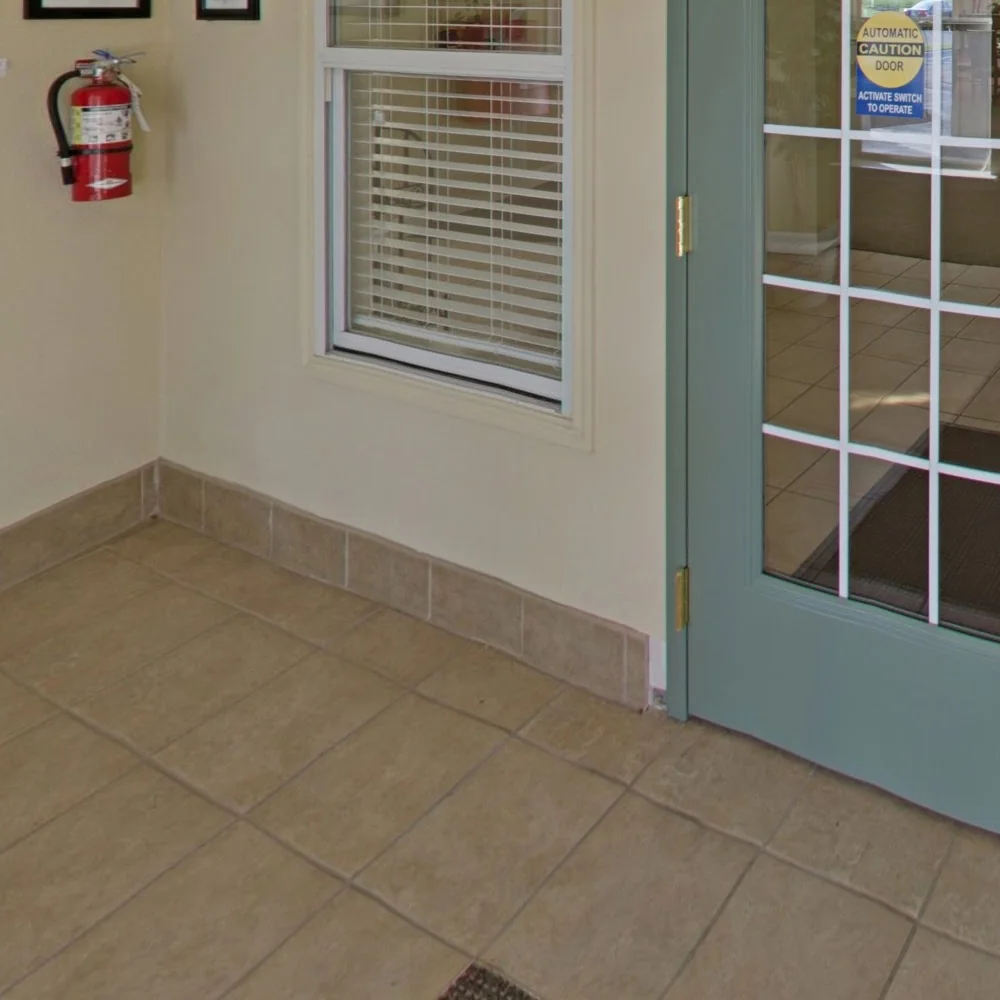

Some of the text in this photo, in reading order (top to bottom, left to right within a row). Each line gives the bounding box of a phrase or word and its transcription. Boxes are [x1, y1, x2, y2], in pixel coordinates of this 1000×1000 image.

[863, 27, 918, 39] AUTOMATIC
[859, 43, 921, 55] CAUTION
[875, 60, 904, 71] DOOR
[858, 91, 922, 103] ACTIVATE SWITCH
[868, 103, 912, 115] TO OPERATE
